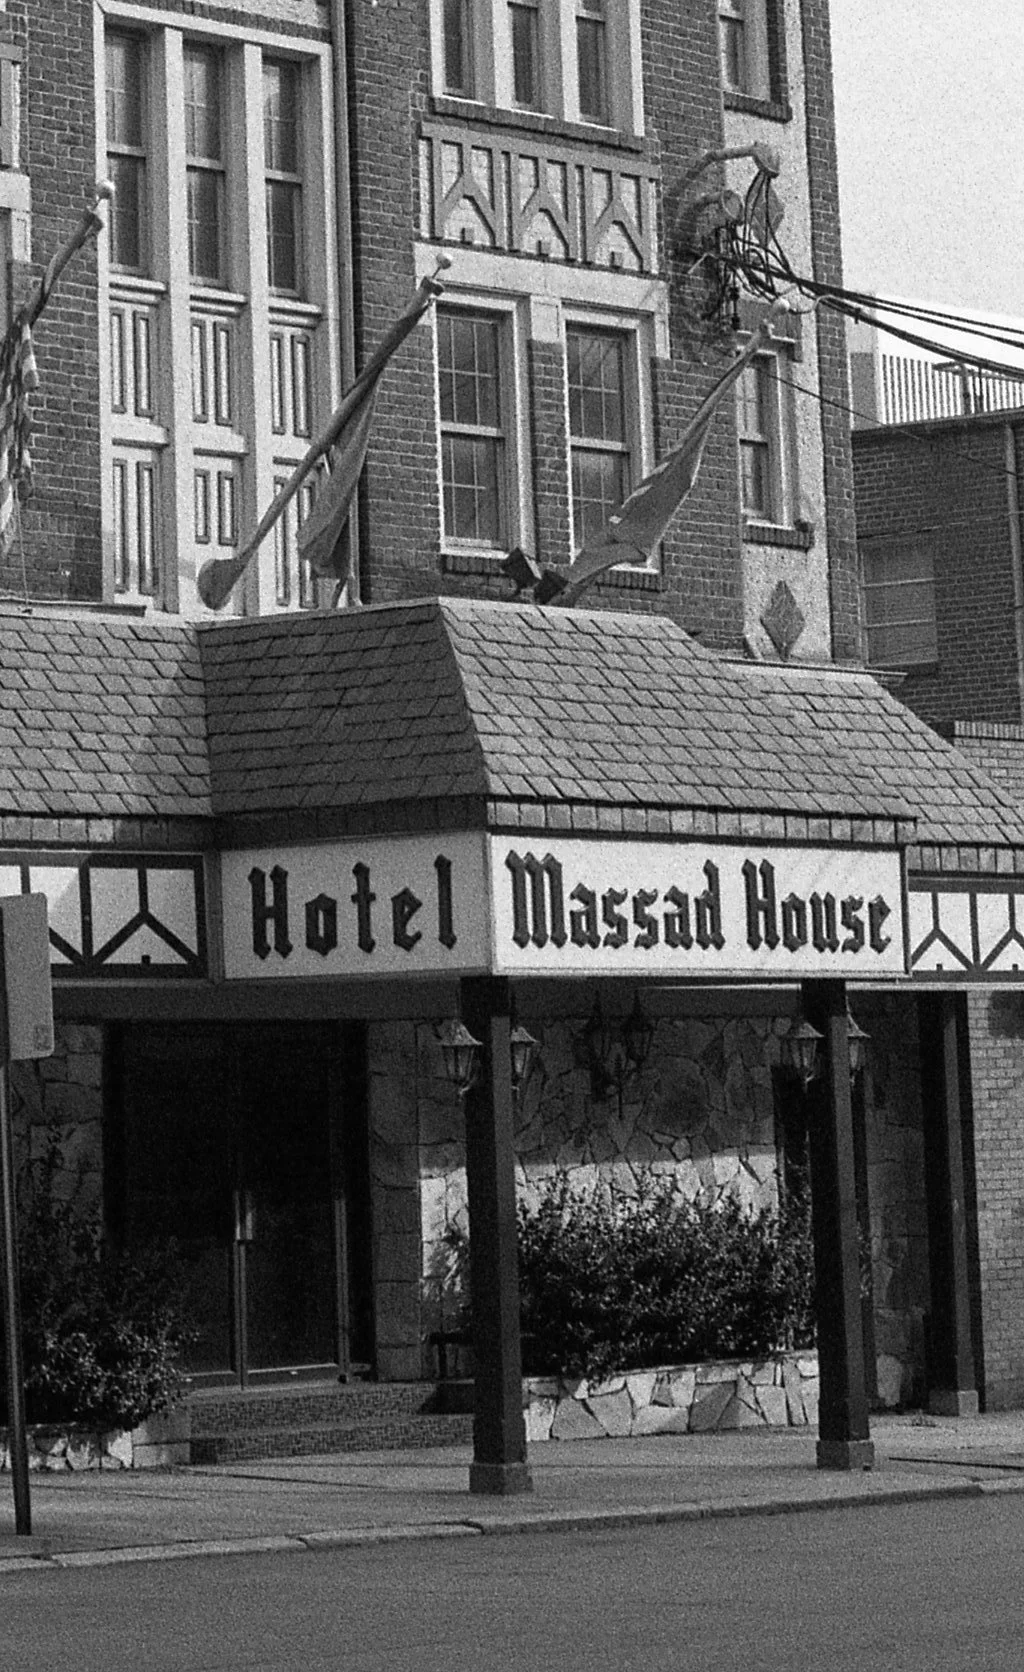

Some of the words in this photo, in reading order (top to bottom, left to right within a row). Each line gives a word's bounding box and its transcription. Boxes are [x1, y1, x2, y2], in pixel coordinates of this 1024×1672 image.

[248, 854, 457, 960] Hotel
[505, 849, 725, 951] Massad
[742, 858, 891, 954] House
